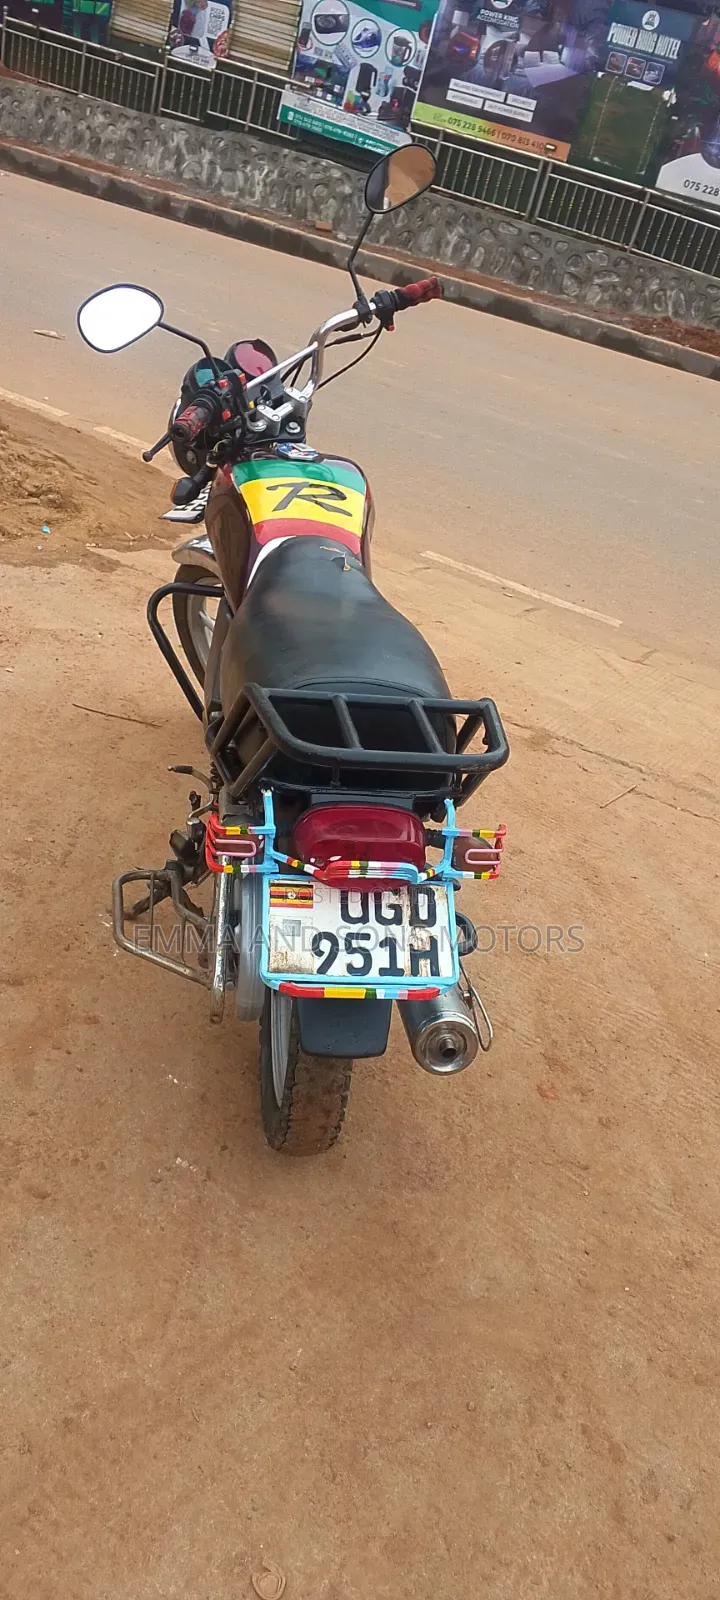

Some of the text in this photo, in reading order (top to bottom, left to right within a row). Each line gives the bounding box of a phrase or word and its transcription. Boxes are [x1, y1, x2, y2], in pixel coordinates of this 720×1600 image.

[480, 8, 503, 19] POWER
[607, 22, 639, 48] POWER
[635, 29, 658, 53] KING
[654, 35, 681, 60] HOTEL
[447, 116, 461, 127] 075
[463, 120, 477, 131] 228
[501, 131, 517, 143] 070
[683, 179, 720, 197] 075 228
[340, 884, 437, 928] UGD
[311, 931, 441, 977] 951H
